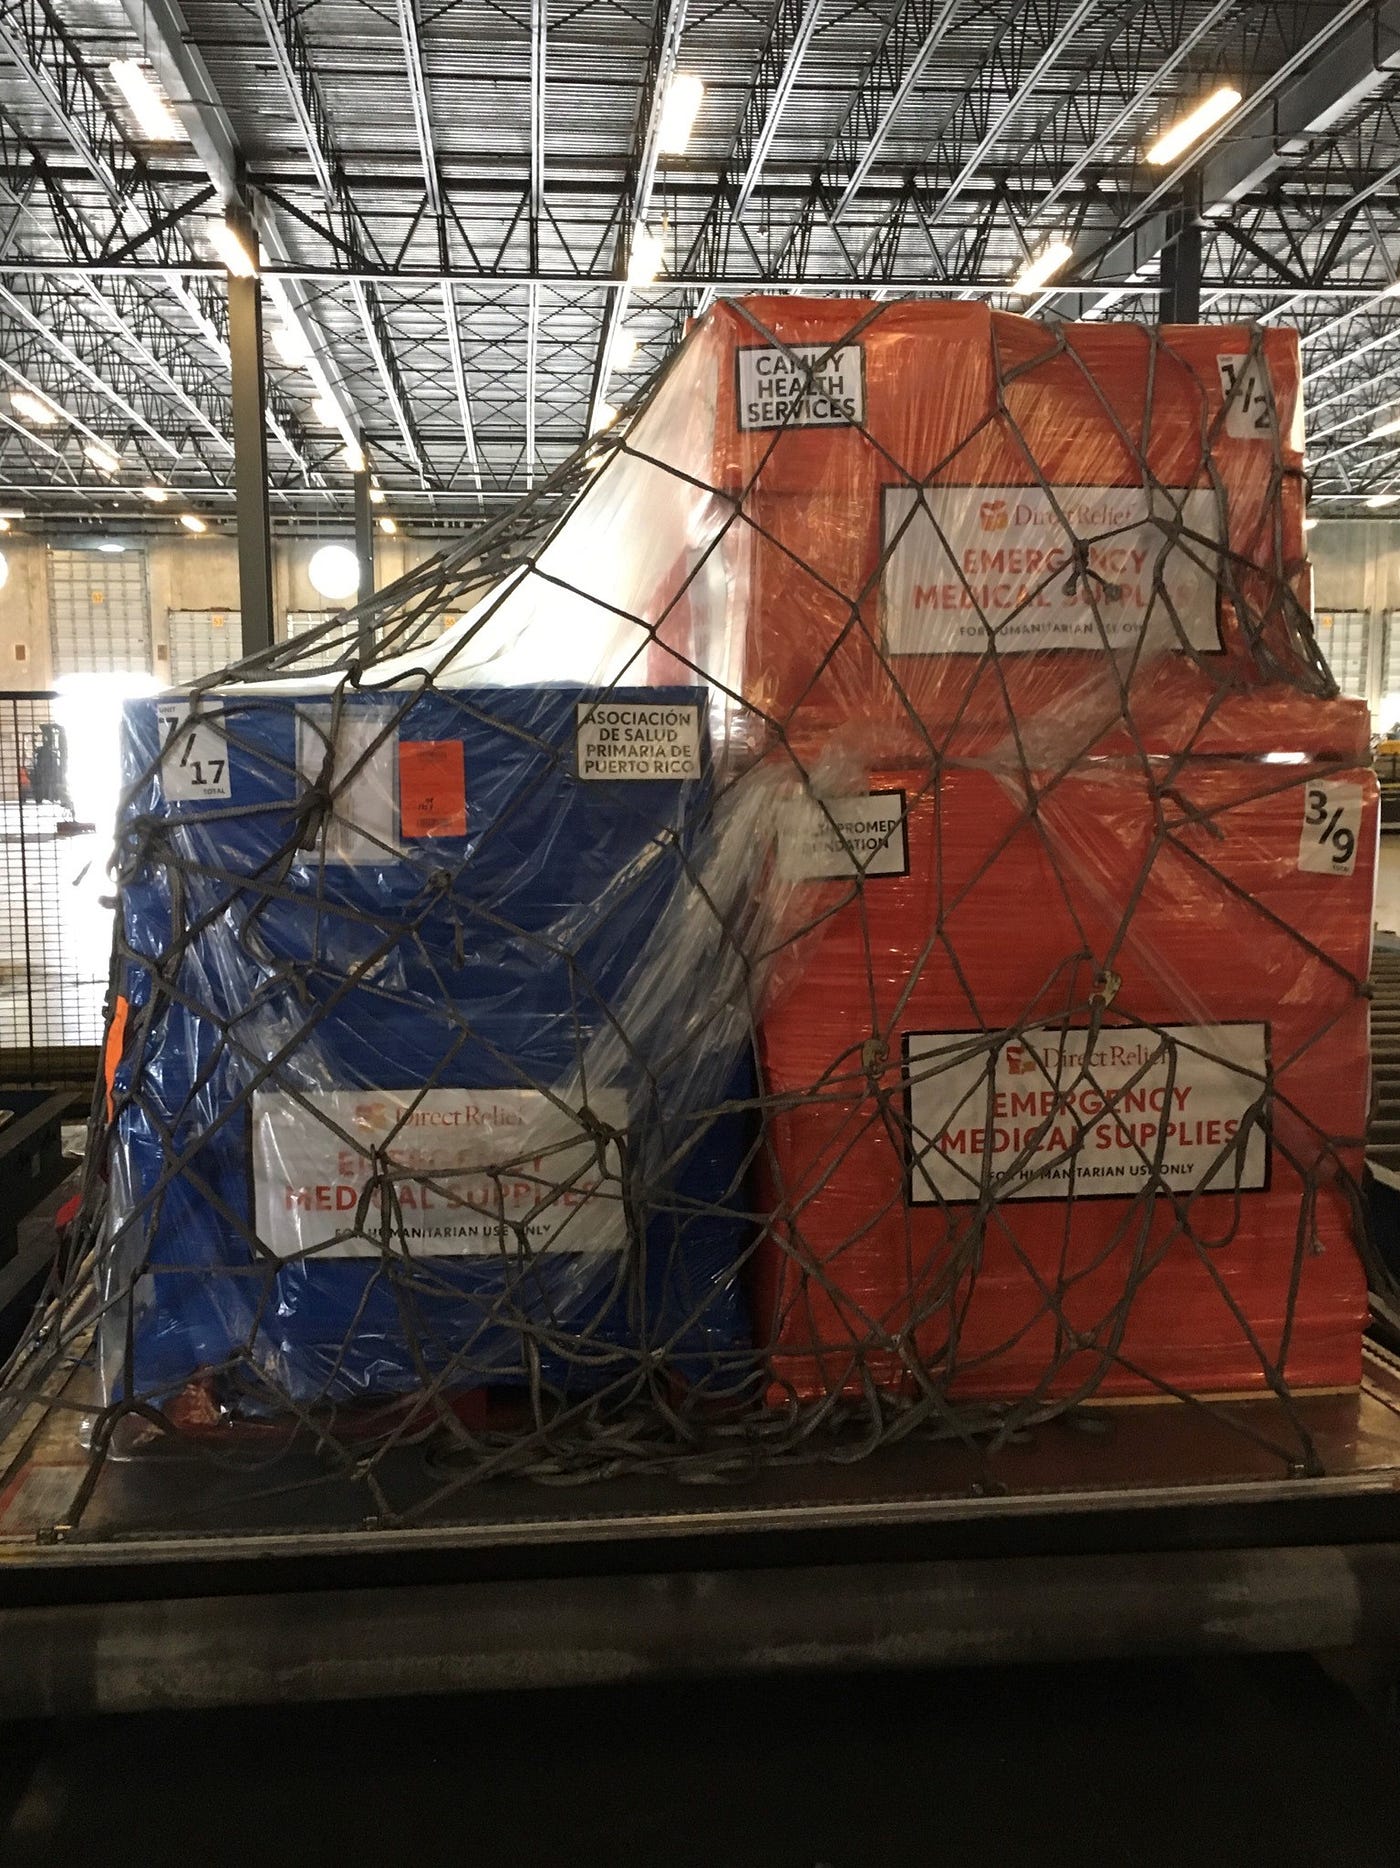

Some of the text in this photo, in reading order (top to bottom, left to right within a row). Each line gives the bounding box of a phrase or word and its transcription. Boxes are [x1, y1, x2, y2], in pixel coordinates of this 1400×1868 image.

[963, 548, 1148, 574] EMERGNCY
[600, 728, 678, 742] DE SALUD
[586, 744, 692, 758] PRIMARIA DE
[585, 760, 695, 774] PUERTO RICO
